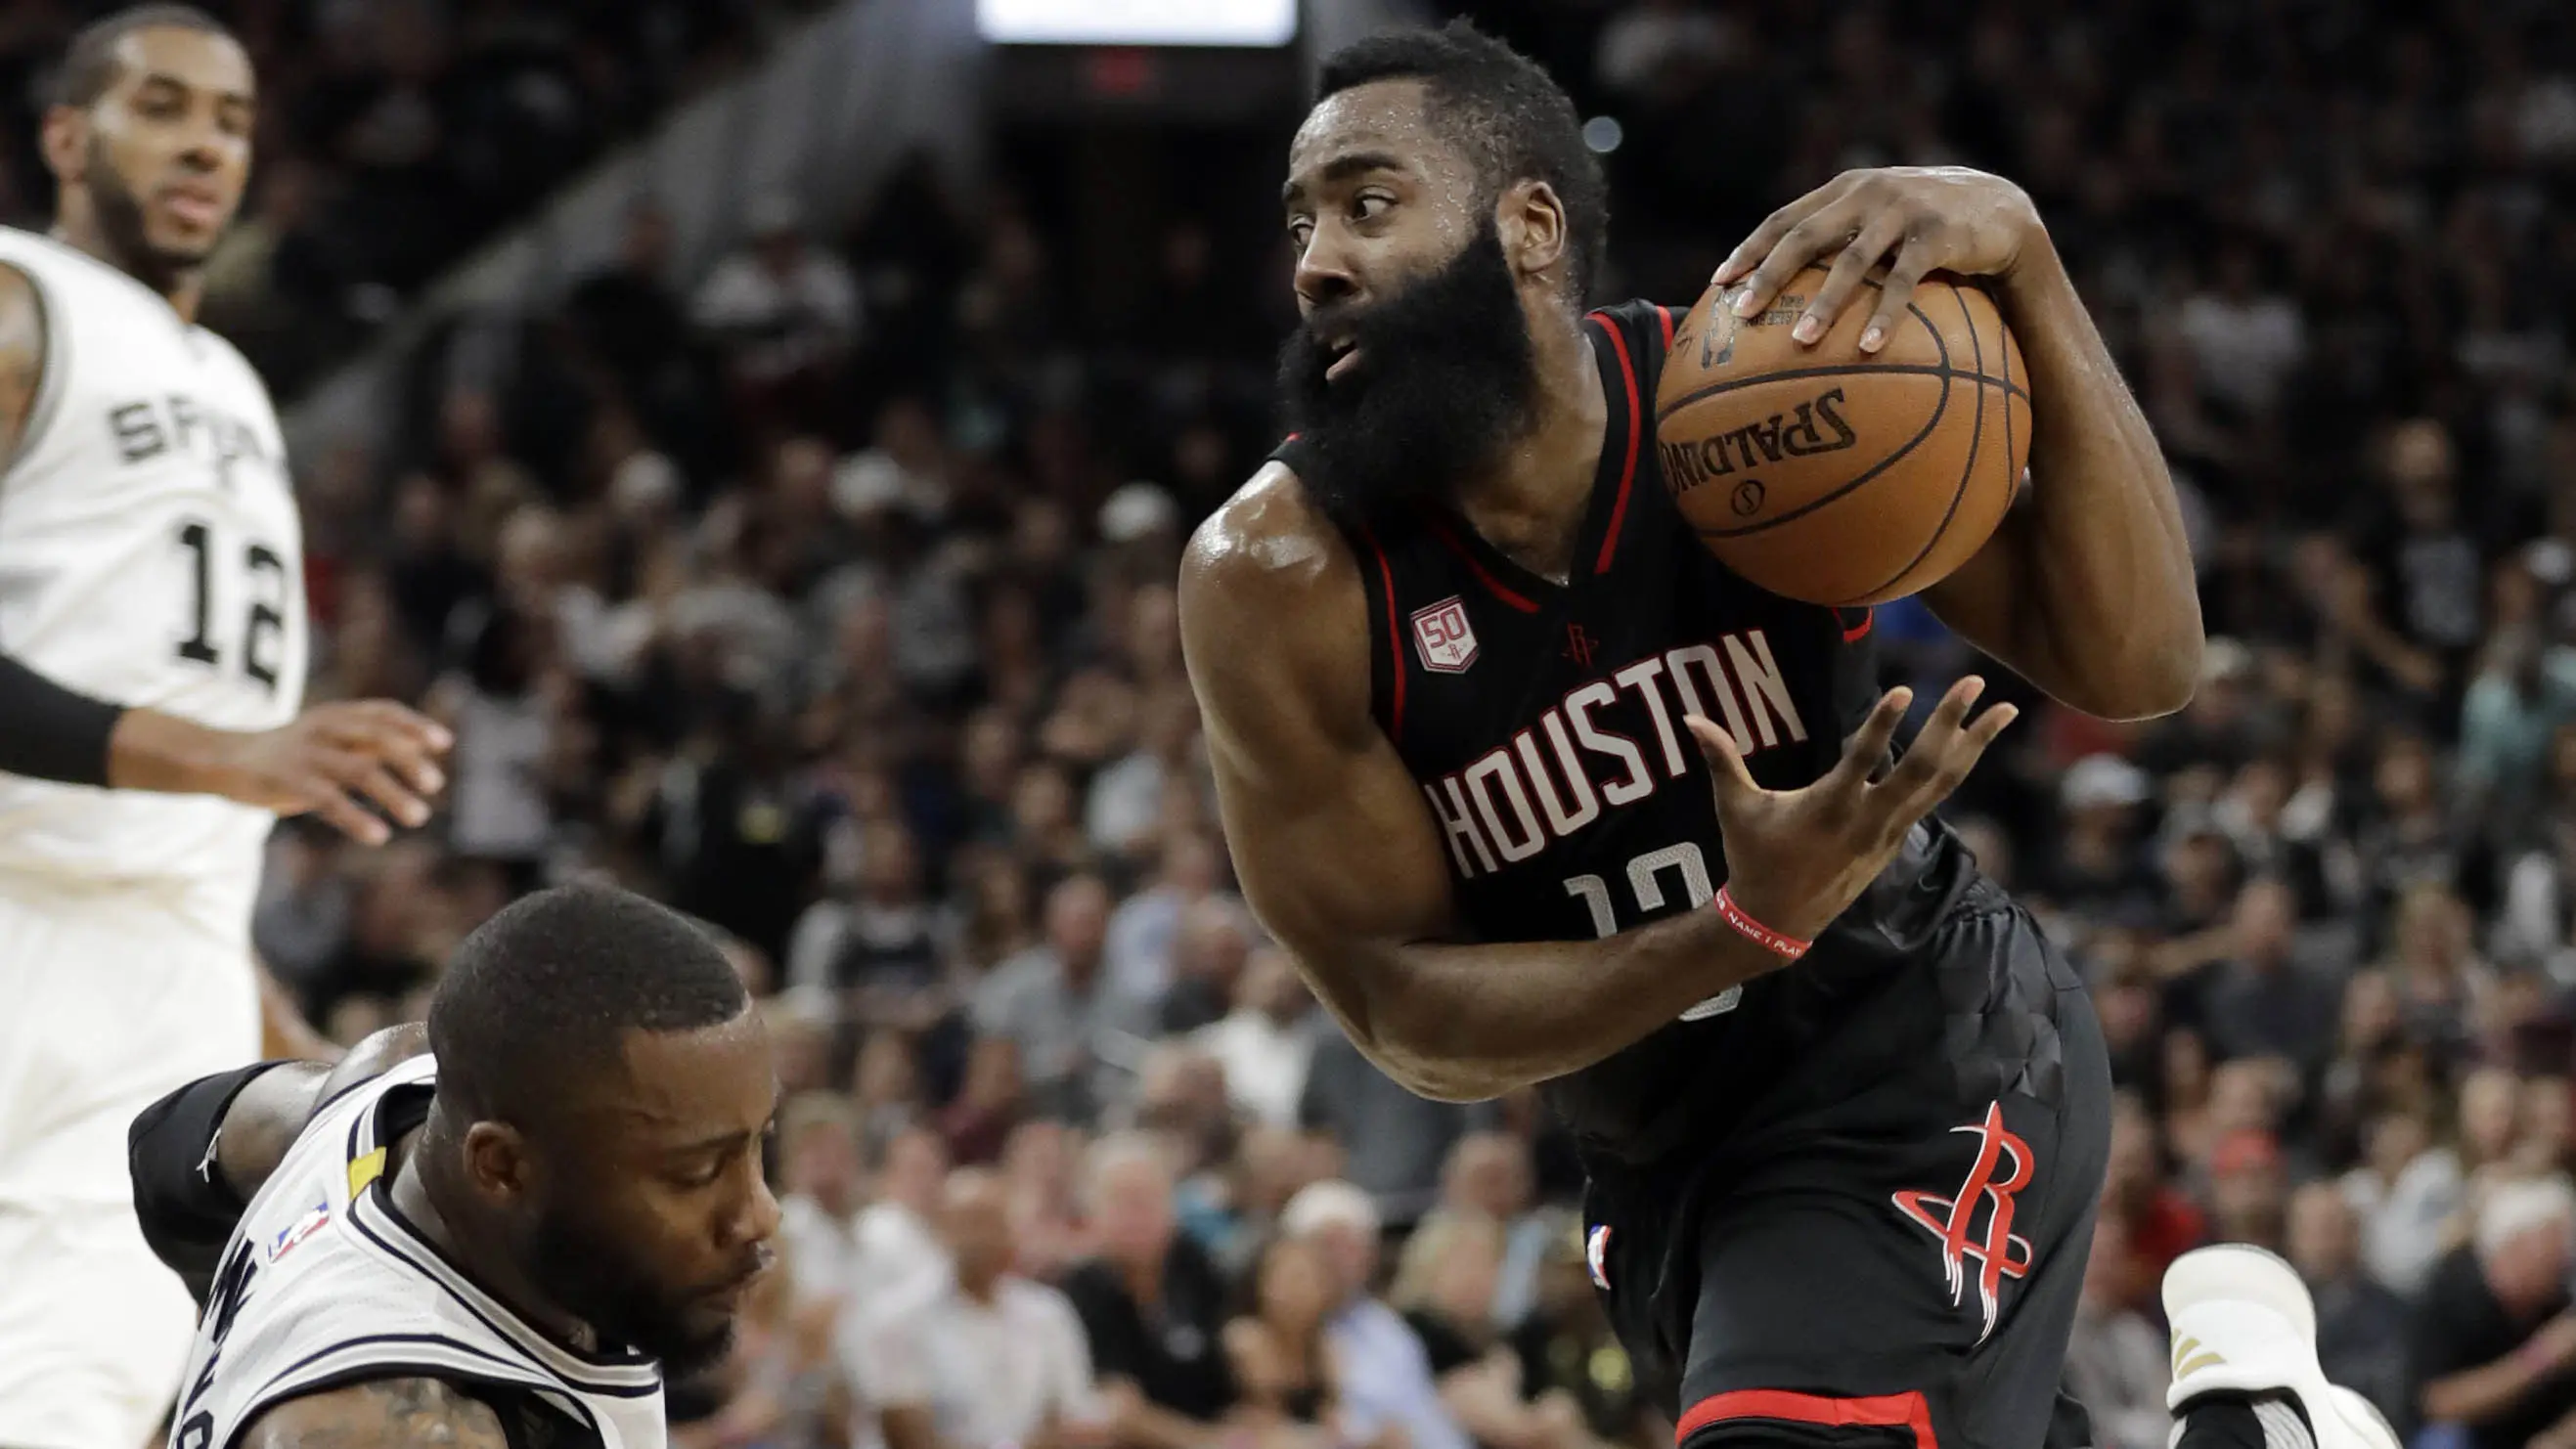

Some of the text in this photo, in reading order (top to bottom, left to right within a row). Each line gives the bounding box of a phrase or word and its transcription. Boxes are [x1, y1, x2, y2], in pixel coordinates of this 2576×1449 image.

[175, 522, 286, 693] 12
[1421, 607, 1466, 648] 50
[1425, 629, 1808, 879] HOUSTON
[1729, 912, 1763, 940] NAME
